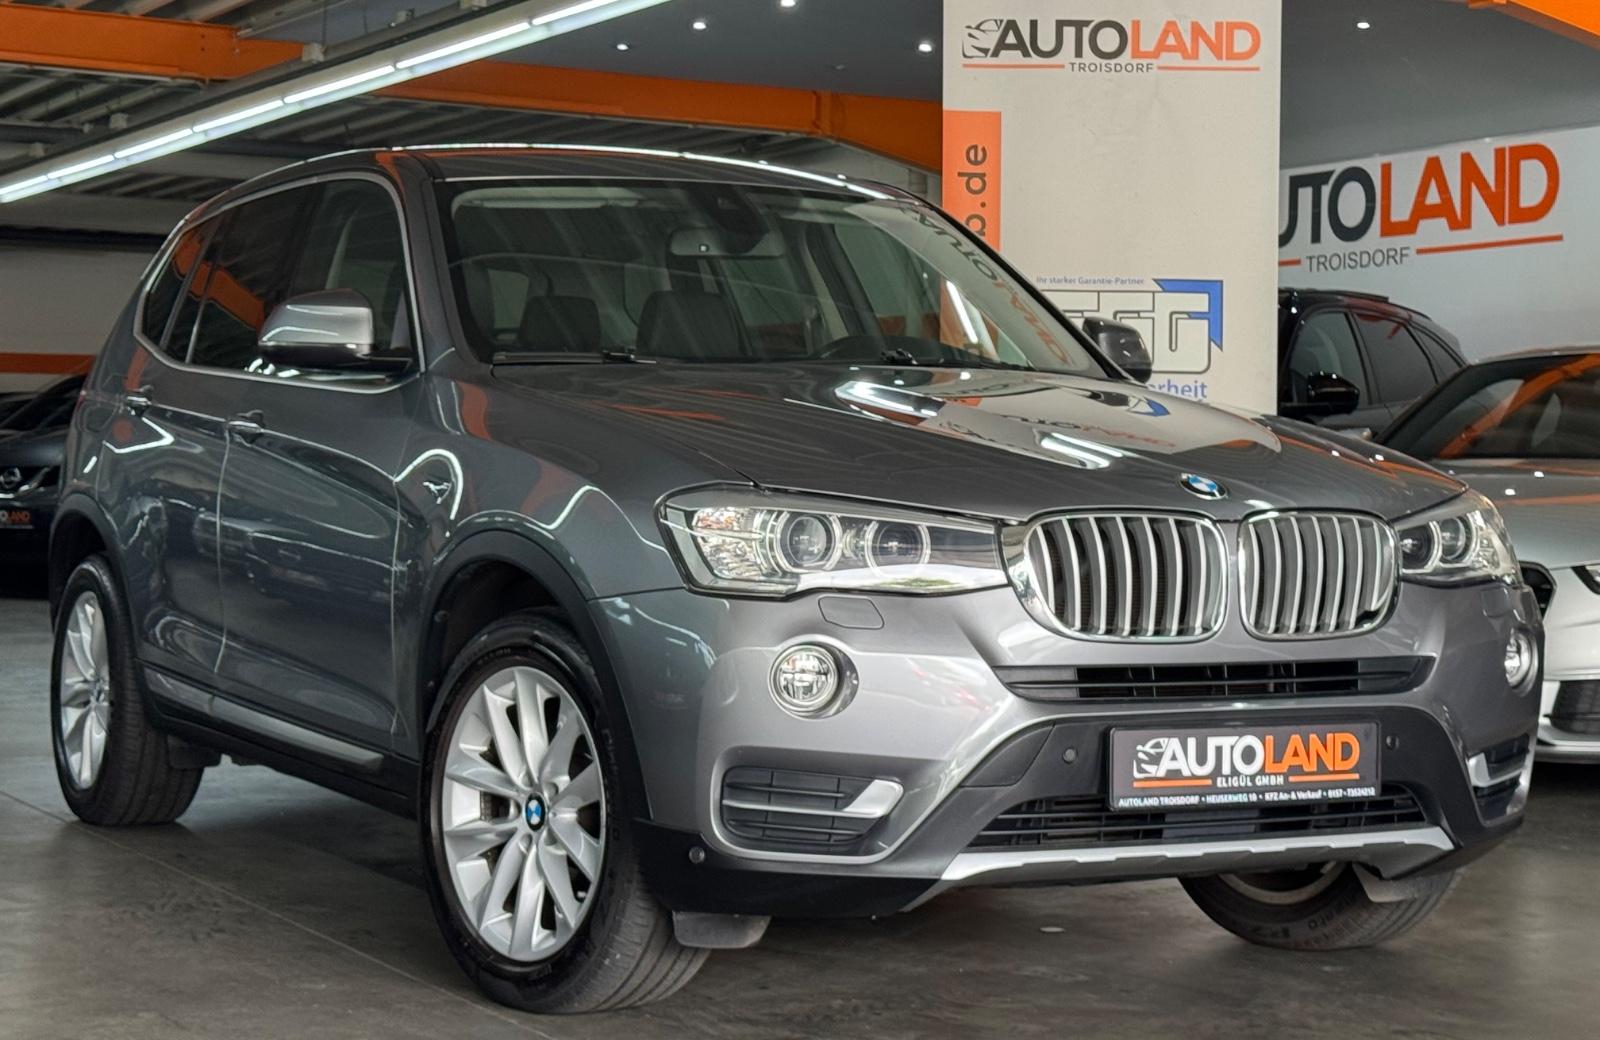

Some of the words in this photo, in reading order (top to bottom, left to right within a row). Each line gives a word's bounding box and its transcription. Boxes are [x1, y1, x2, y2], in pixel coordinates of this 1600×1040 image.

[989, 18, 1261, 61] AUTOLAND
[1069, 62, 1155, 73] TROISDORF
[1278, 143, 1561, 249] UTOLAND
[1305, 246, 1411, 273] TROISDORF
[1050, 276, 1077, 285] starker
[1148, 379, 1207, 399] rheit
[1156, 732, 1361, 777] AUTOLAND
[1216, 774, 1253, 788] ELIGÜL
[1255, 774, 1285, 787] GMBH
[1118, 797, 1159, 808] AUTOLAND
